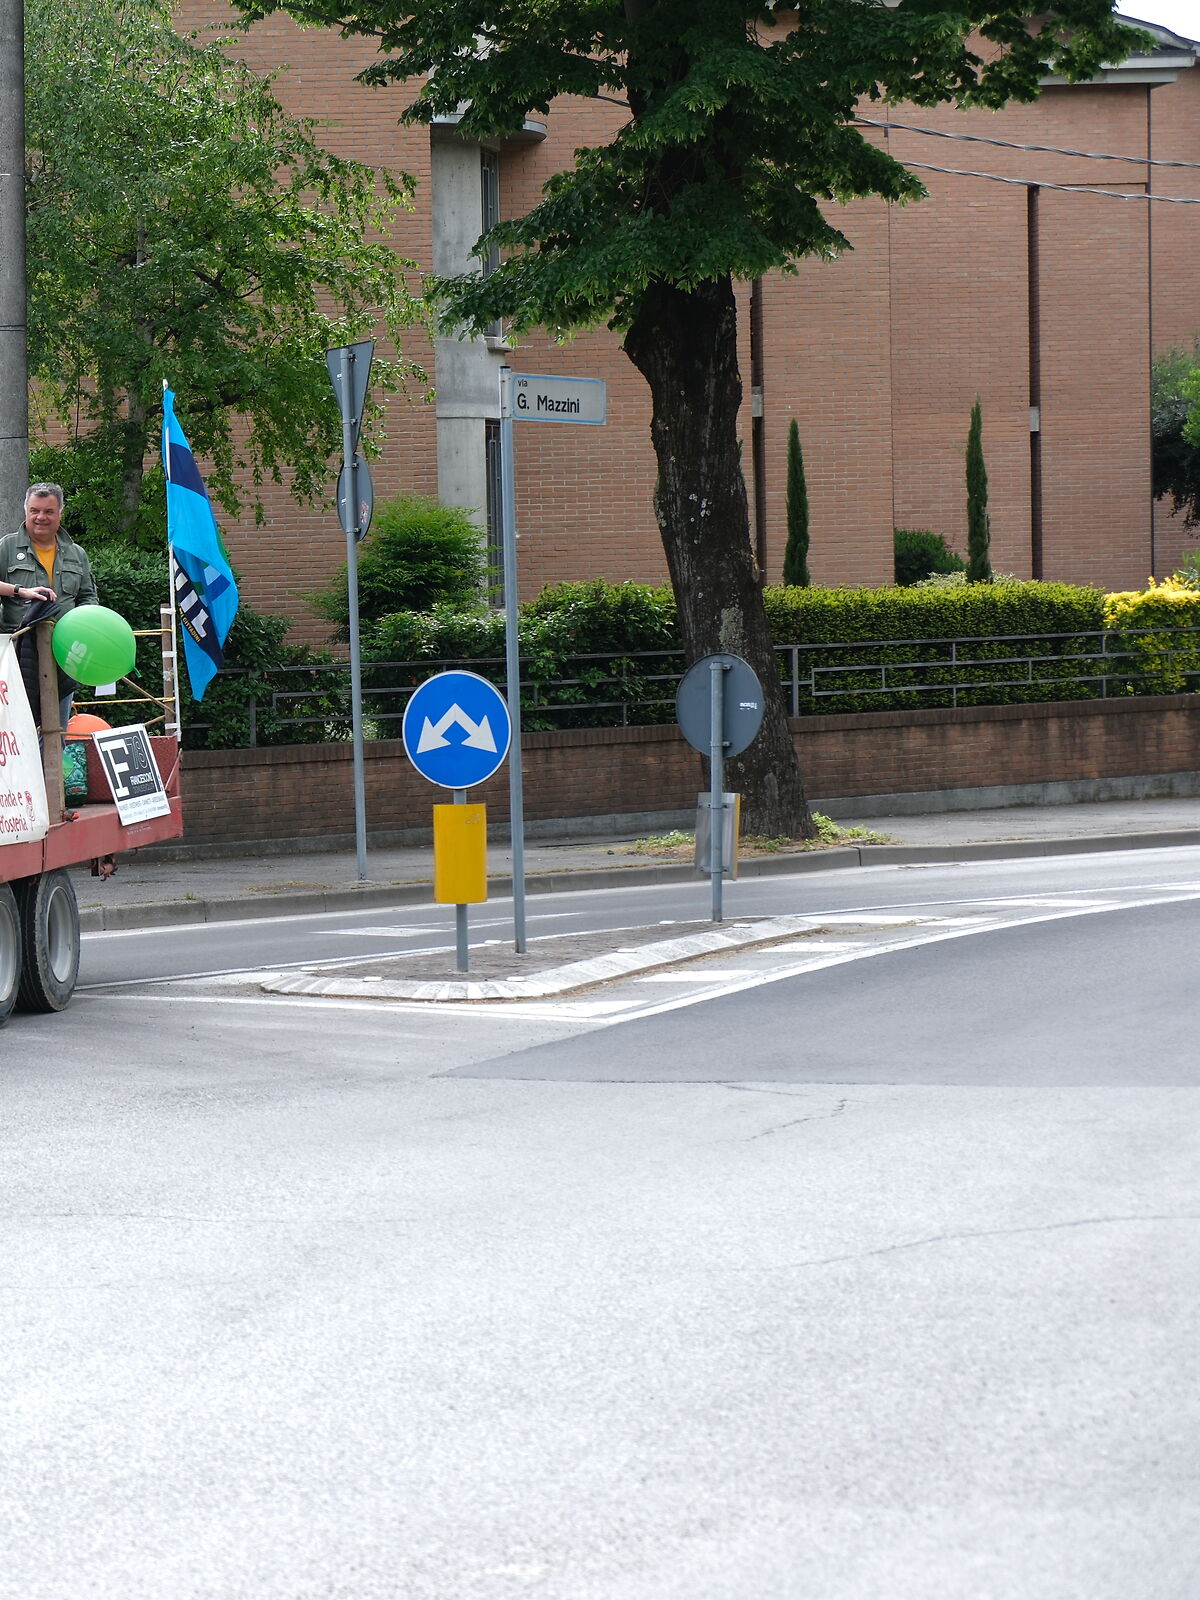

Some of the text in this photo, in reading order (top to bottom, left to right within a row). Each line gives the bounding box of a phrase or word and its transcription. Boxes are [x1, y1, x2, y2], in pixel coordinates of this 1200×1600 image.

[517, 378, 528, 388] via
[517, 393, 580, 413] G. Mazzini
[17, 792, 23, 806] e
